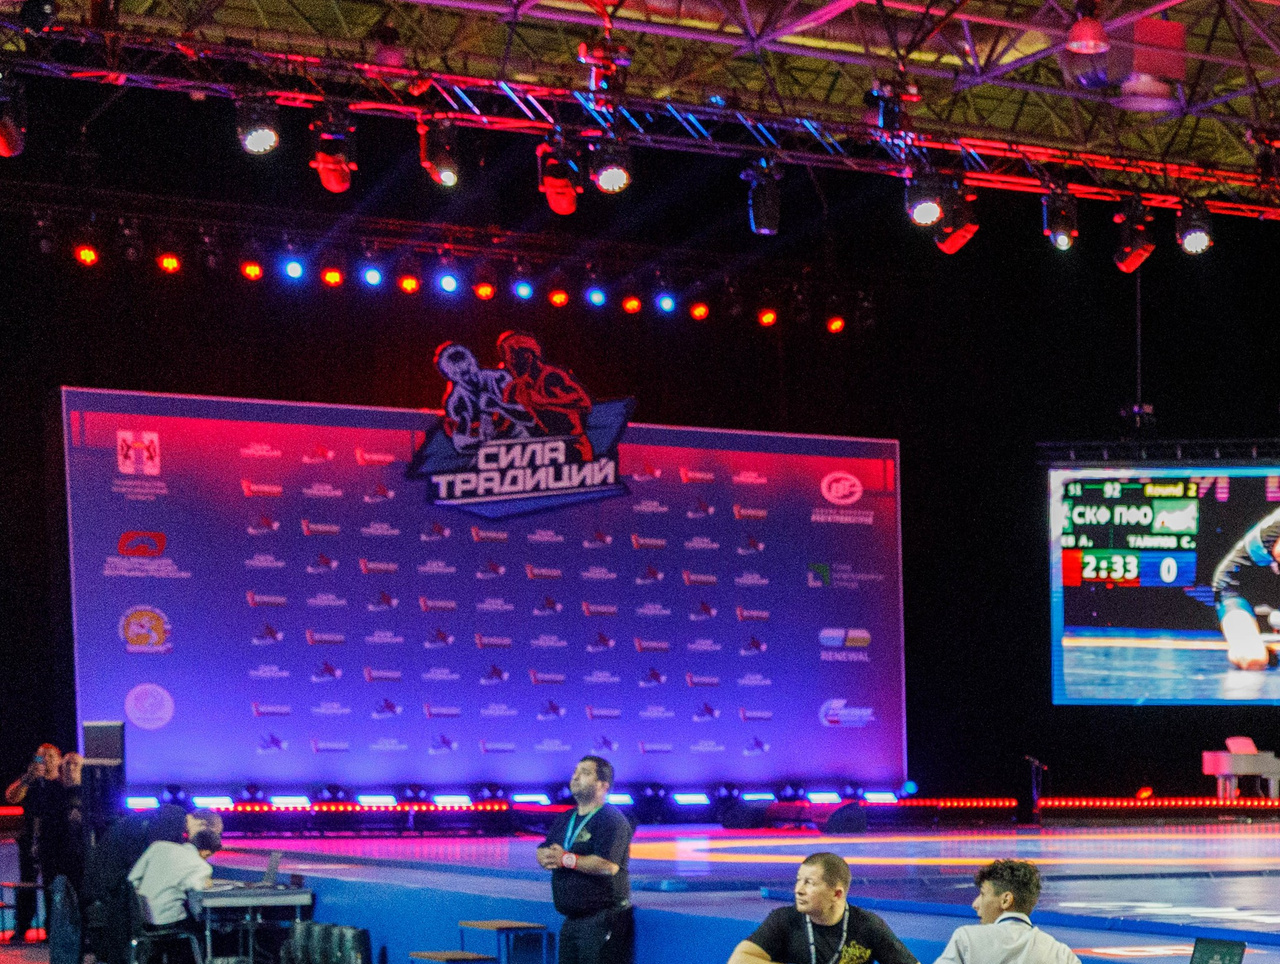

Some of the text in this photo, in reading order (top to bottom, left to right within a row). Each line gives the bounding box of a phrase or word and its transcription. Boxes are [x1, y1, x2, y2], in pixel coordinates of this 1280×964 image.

[477, 440, 566, 471] СИЛА
[431, 457, 616, 498] ТРАДИЦИЙ
[1103, 481, 1121, 498] 92
[1144, 481, 1184, 497] Round
[1187, 482, 1198, 498] 2
[1072, 504, 1154, 526] СКФ ПФО
[1082, 554, 1177, 583] 2:33 0
